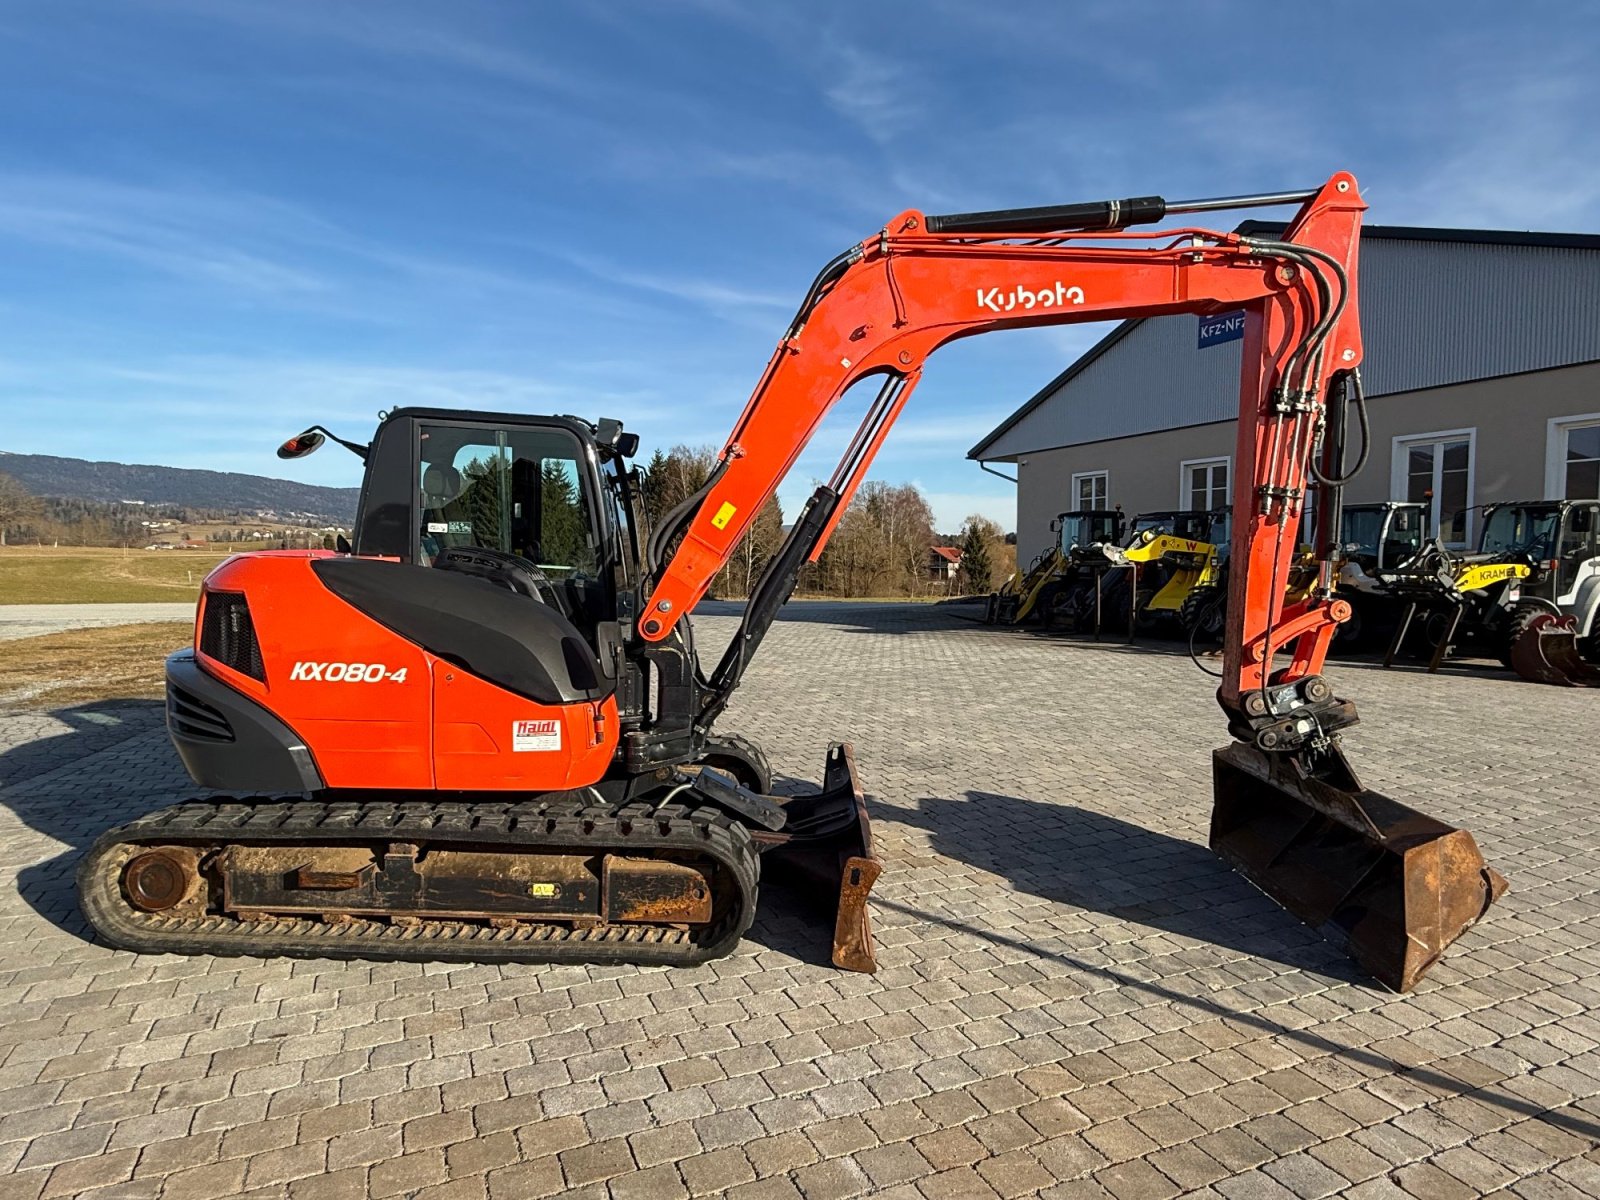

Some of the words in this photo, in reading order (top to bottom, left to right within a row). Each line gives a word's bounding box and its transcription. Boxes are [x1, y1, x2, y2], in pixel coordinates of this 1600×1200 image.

[977, 281, 1084, 312] Kubota
[1480, 566, 1517, 580] KRAMER
[290, 662, 408, 683] KX080-4
